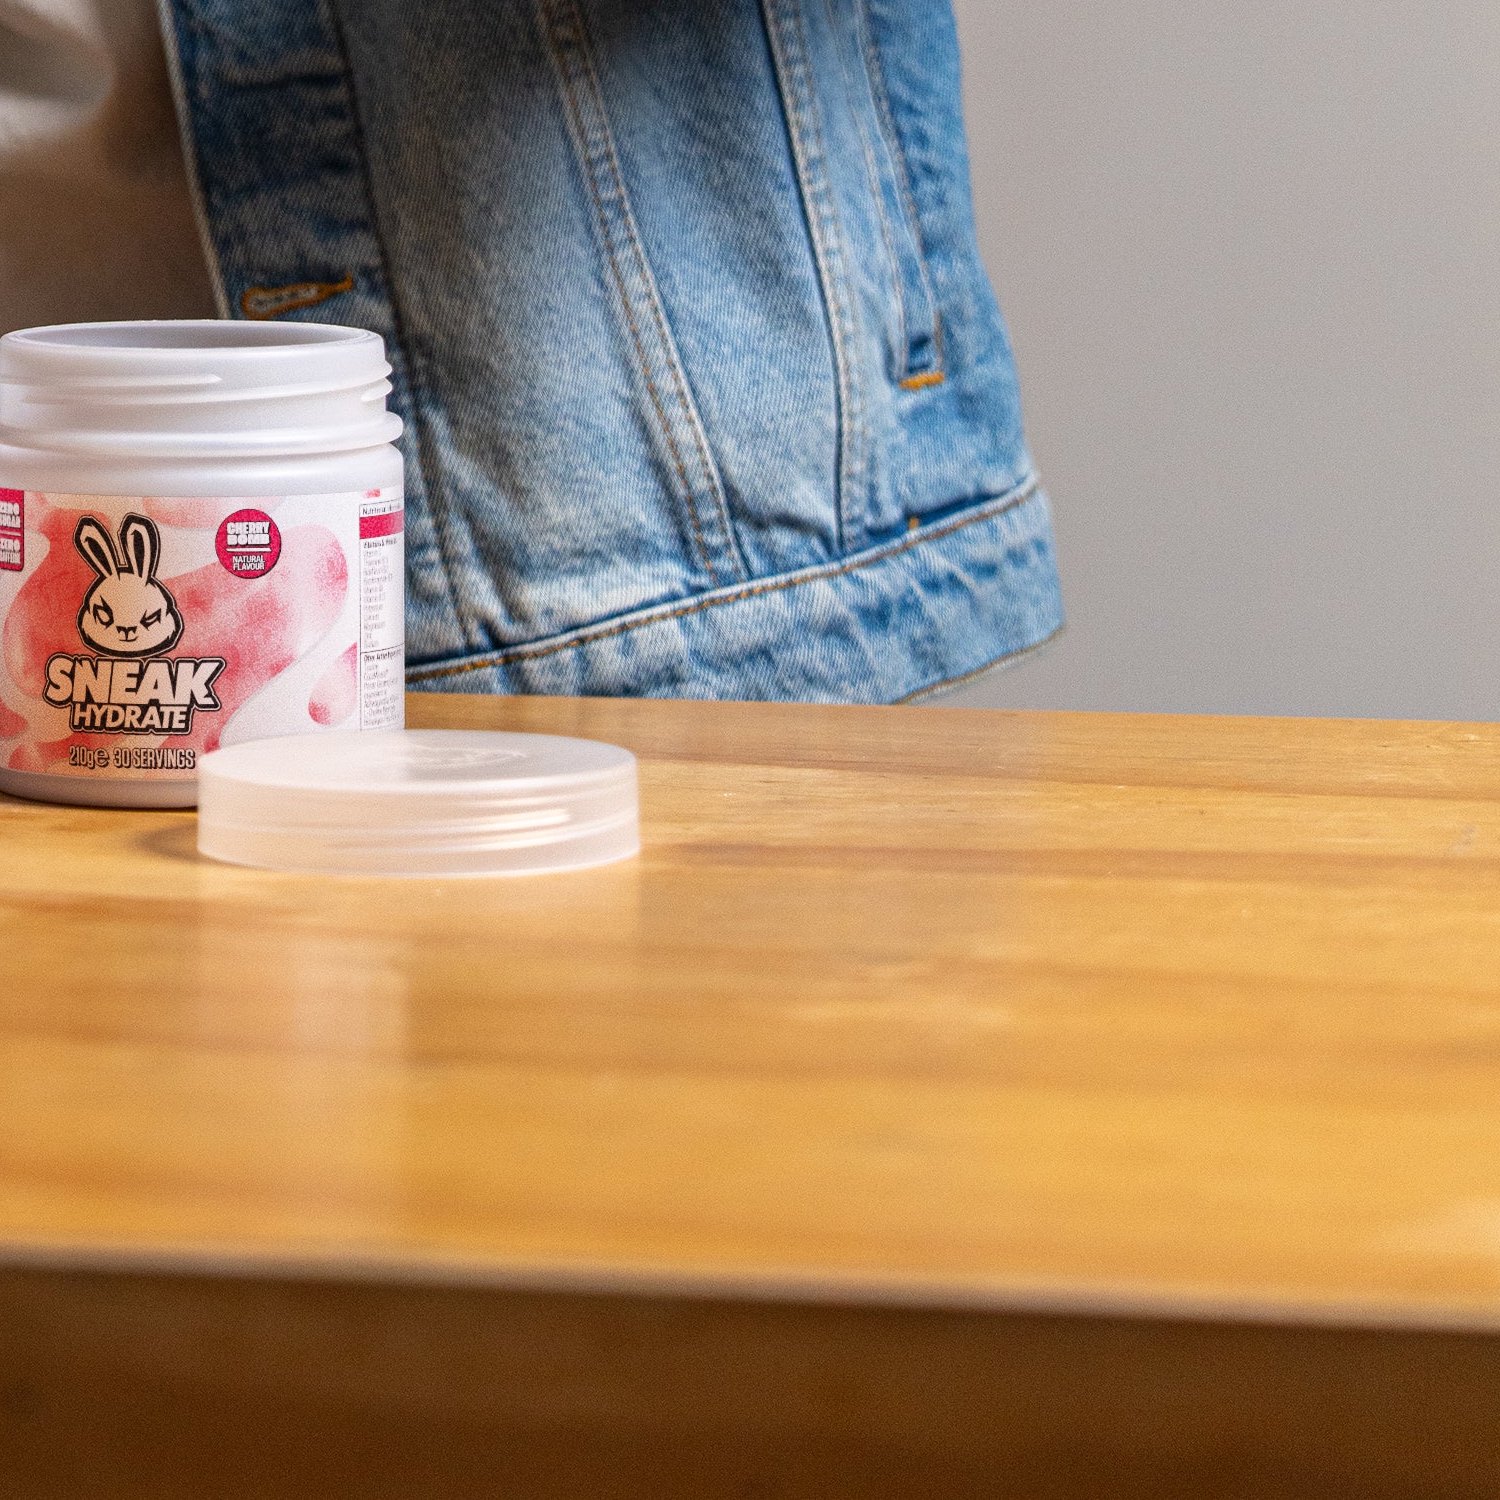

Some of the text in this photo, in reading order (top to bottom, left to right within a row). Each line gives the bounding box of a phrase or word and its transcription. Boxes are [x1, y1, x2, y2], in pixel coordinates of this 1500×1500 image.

[226, 521, 271, 535] CHERRY
[232, 555, 265, 563] NATURAL
[233, 562, 265, 571] FLAVOUR
[45, 656, 222, 706] SNEAK
[72, 703, 188, 729] HYDRATE
[112, 748, 132, 769] 30
[132, 748, 196, 769] SERVINGS
